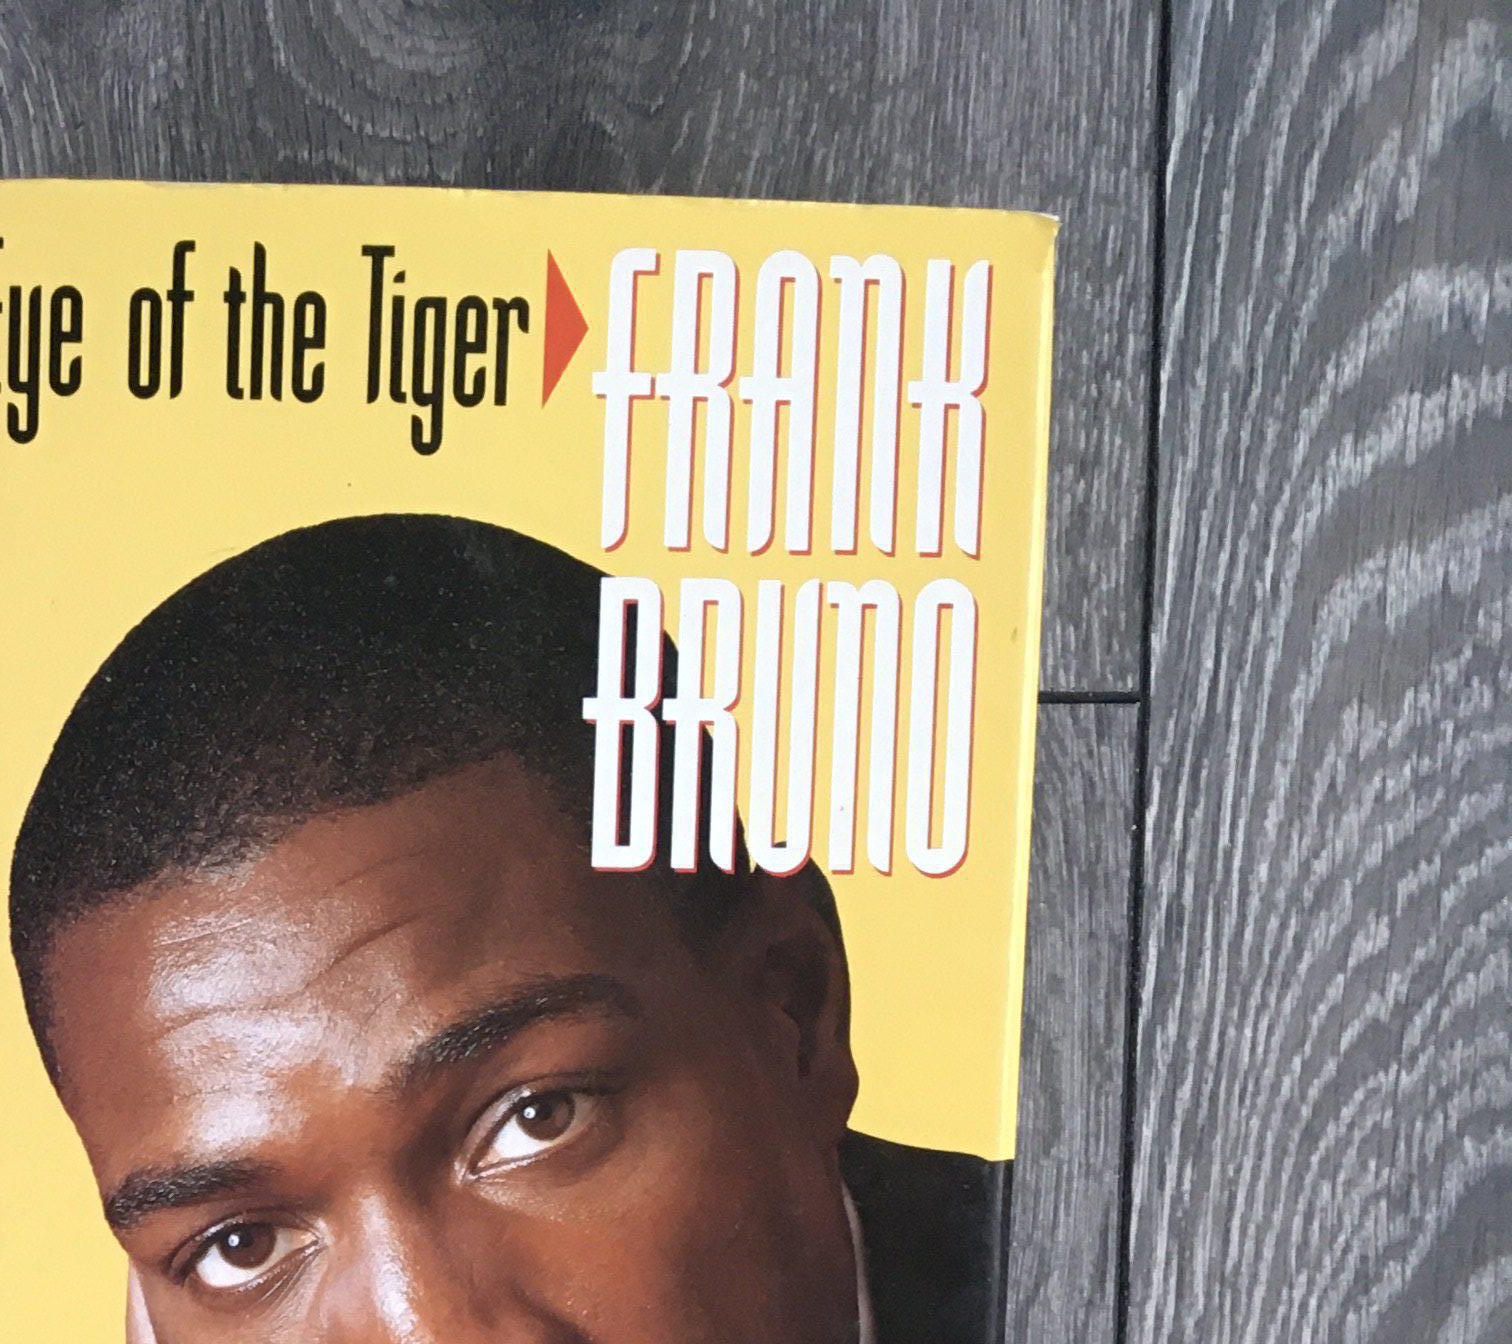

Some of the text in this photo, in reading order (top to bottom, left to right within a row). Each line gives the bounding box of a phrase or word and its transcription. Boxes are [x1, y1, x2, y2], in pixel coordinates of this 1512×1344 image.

[128, 240, 196, 399] of
[224, 241, 326, 403] the
[362, 245, 529, 455] Tiger
[591, 246, 994, 560] FRANK
[582, 575, 978, 875] BRUNO
